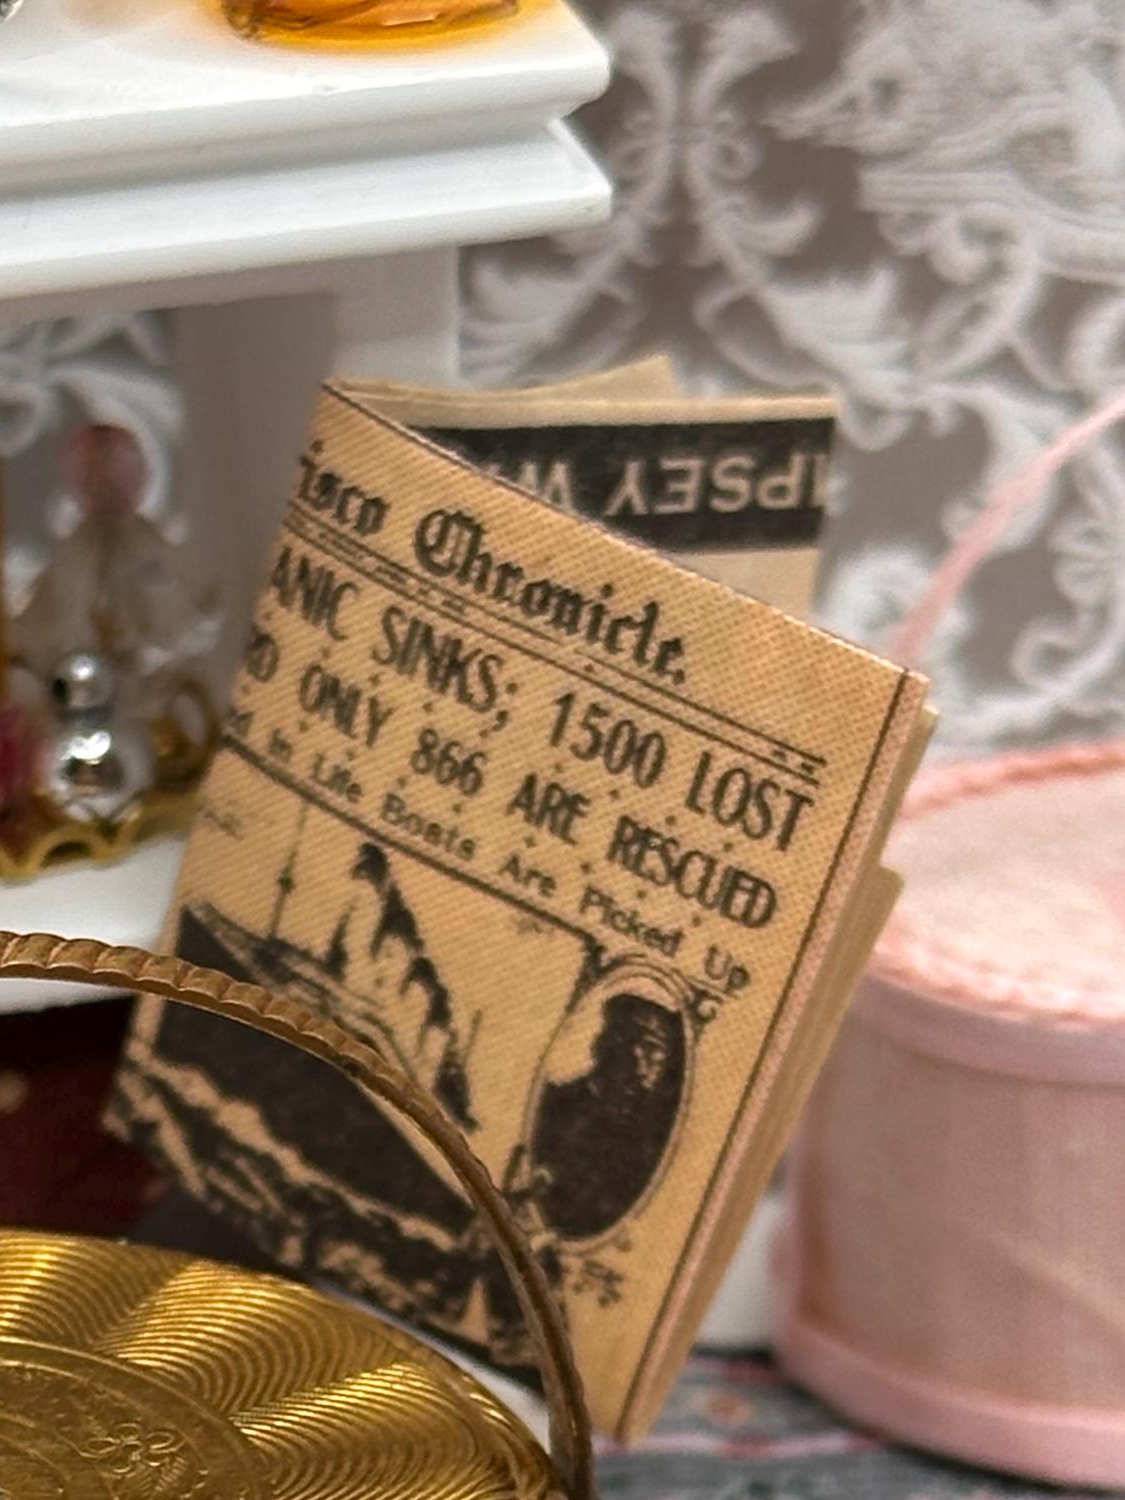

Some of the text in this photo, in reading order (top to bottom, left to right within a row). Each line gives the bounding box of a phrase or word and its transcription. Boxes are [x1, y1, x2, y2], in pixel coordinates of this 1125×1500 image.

[412, 508, 687, 685] Chronicle.
[299, 663, 396, 749] ONLY
[409, 728, 489, 797] 866
[504, 771, 593, 846] ARE
[606, 815, 779, 930] RESCUED
[372, 603, 517, 733] SINKS;
[549, 691, 668, 790] 1500
[685, 750, 815, 852] LOST
[309, 751, 364, 804] Life
[380, 792, 478, 862] Boats
[497, 853, 558, 899] Are
[578, 882, 687, 958] Picked
[703, 943, 752, 997] Up
